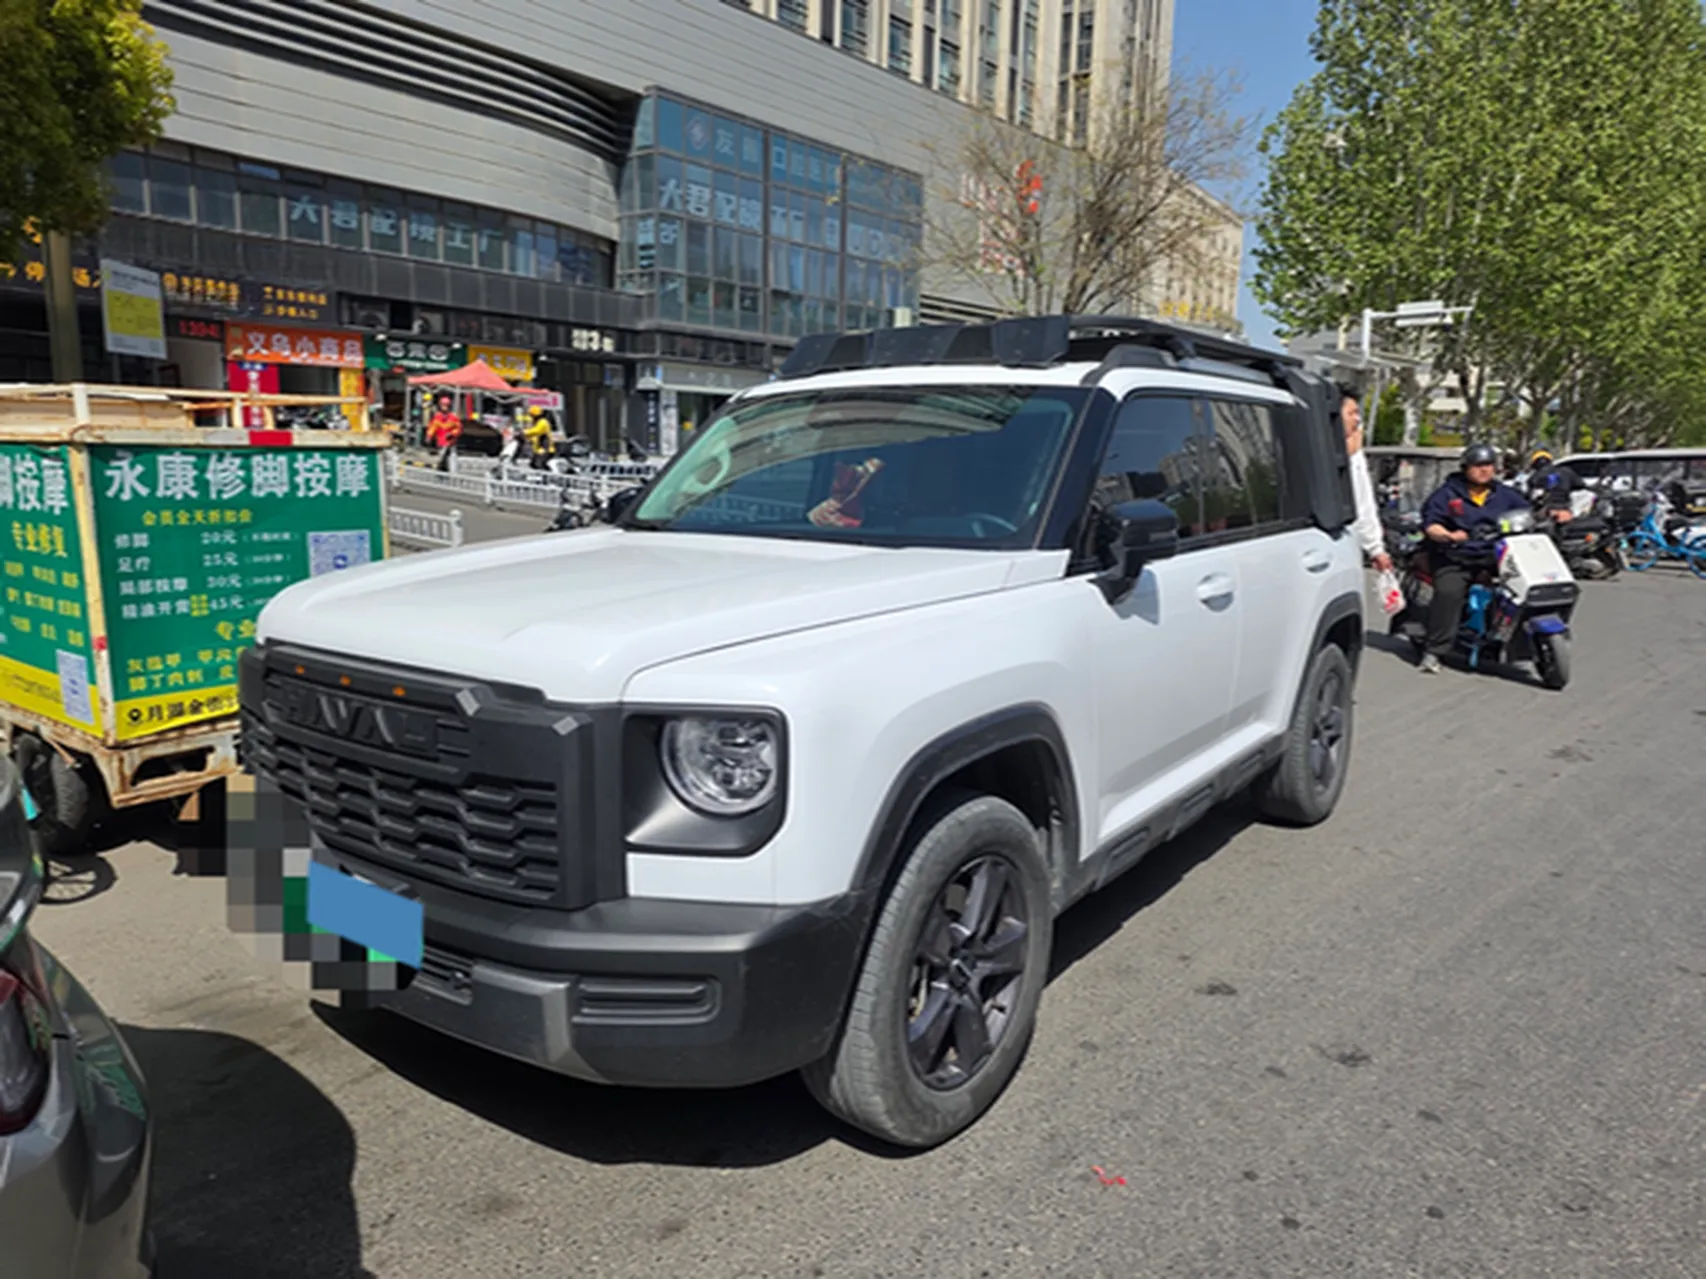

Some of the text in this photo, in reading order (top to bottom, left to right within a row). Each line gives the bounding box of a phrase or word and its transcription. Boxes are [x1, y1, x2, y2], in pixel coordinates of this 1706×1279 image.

[247, 331, 362, 360] 义乌小商品
[104, 452, 372, 501] 永康修脚按摩
[114, 532, 150, 549] 修脚
